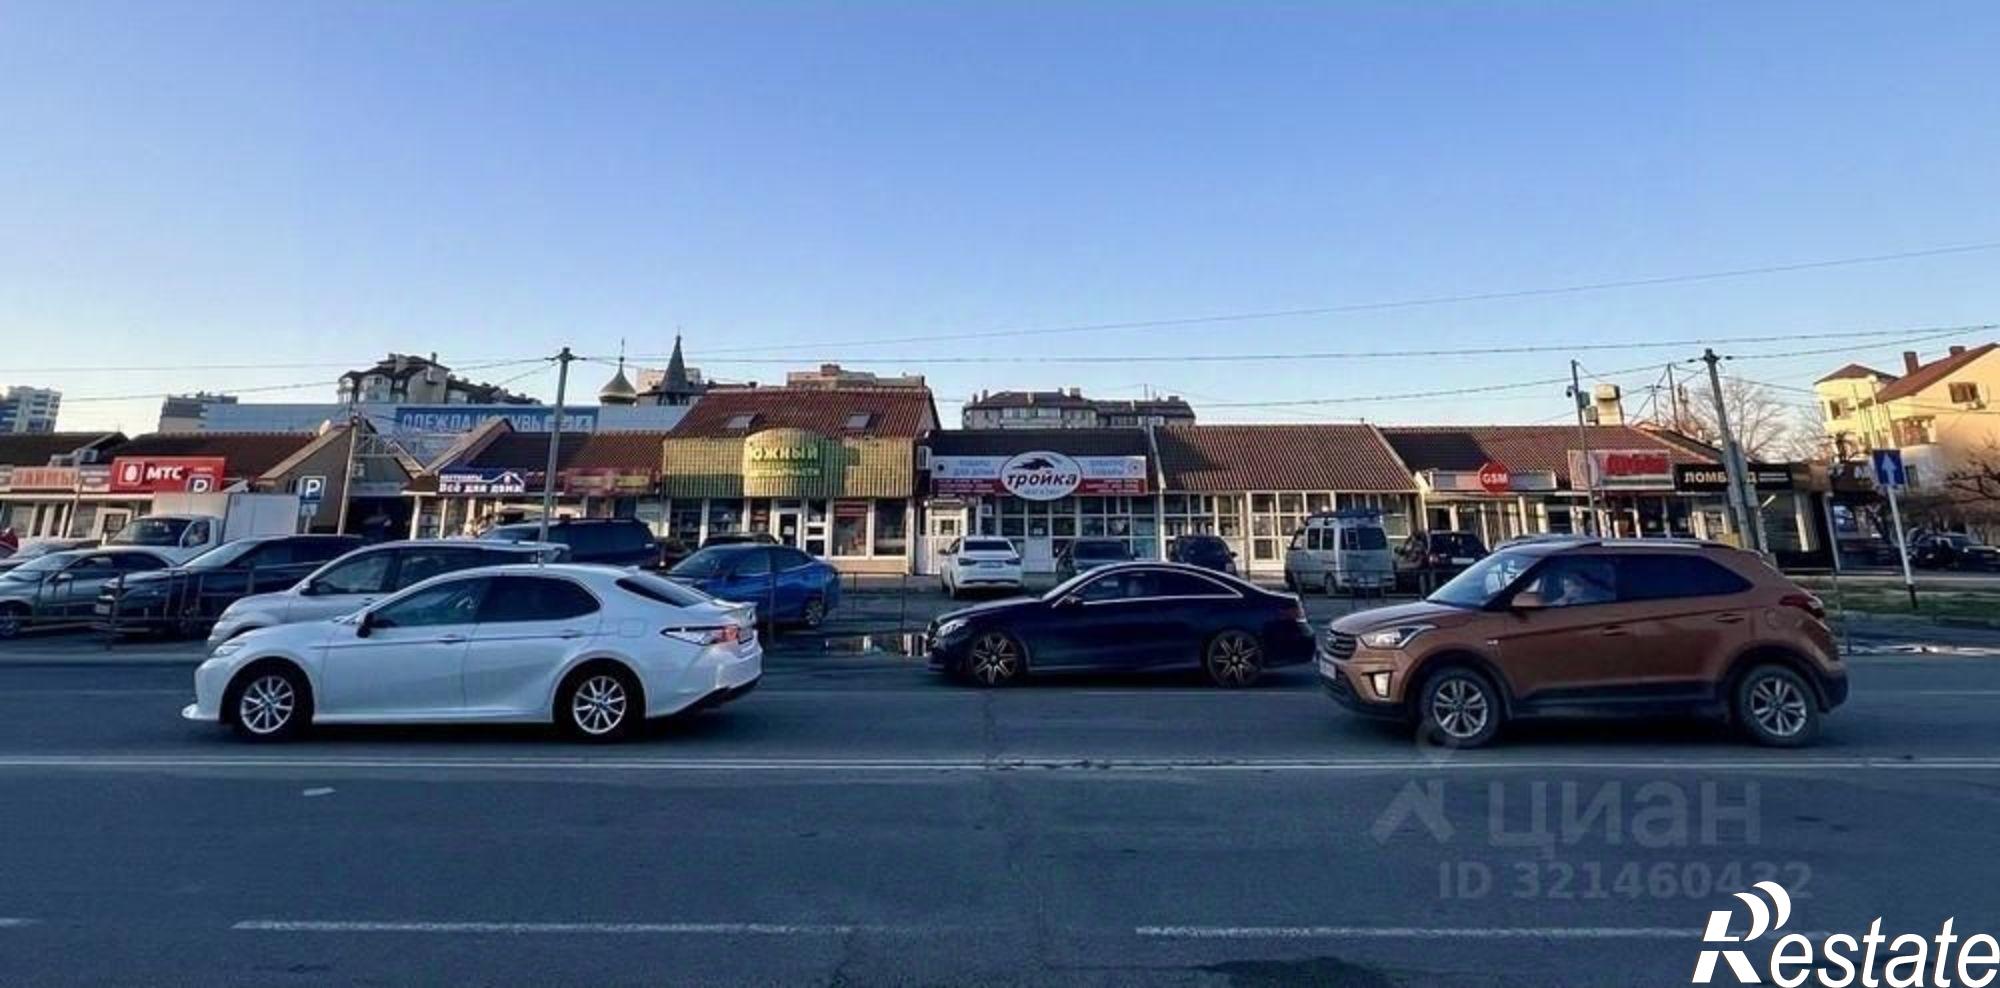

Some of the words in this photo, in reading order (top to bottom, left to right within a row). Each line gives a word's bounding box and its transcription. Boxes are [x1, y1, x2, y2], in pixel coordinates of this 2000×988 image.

[402, 413, 467, 431] ОДЕЖДА
[146, 466, 183, 480] МТС
[1007, 470, 1078, 489] тройка
[1482, 473, 1508, 484] GSM
[1684, 471, 1757, 484] ЛОМБД
[305, 479, 321, 497] P
